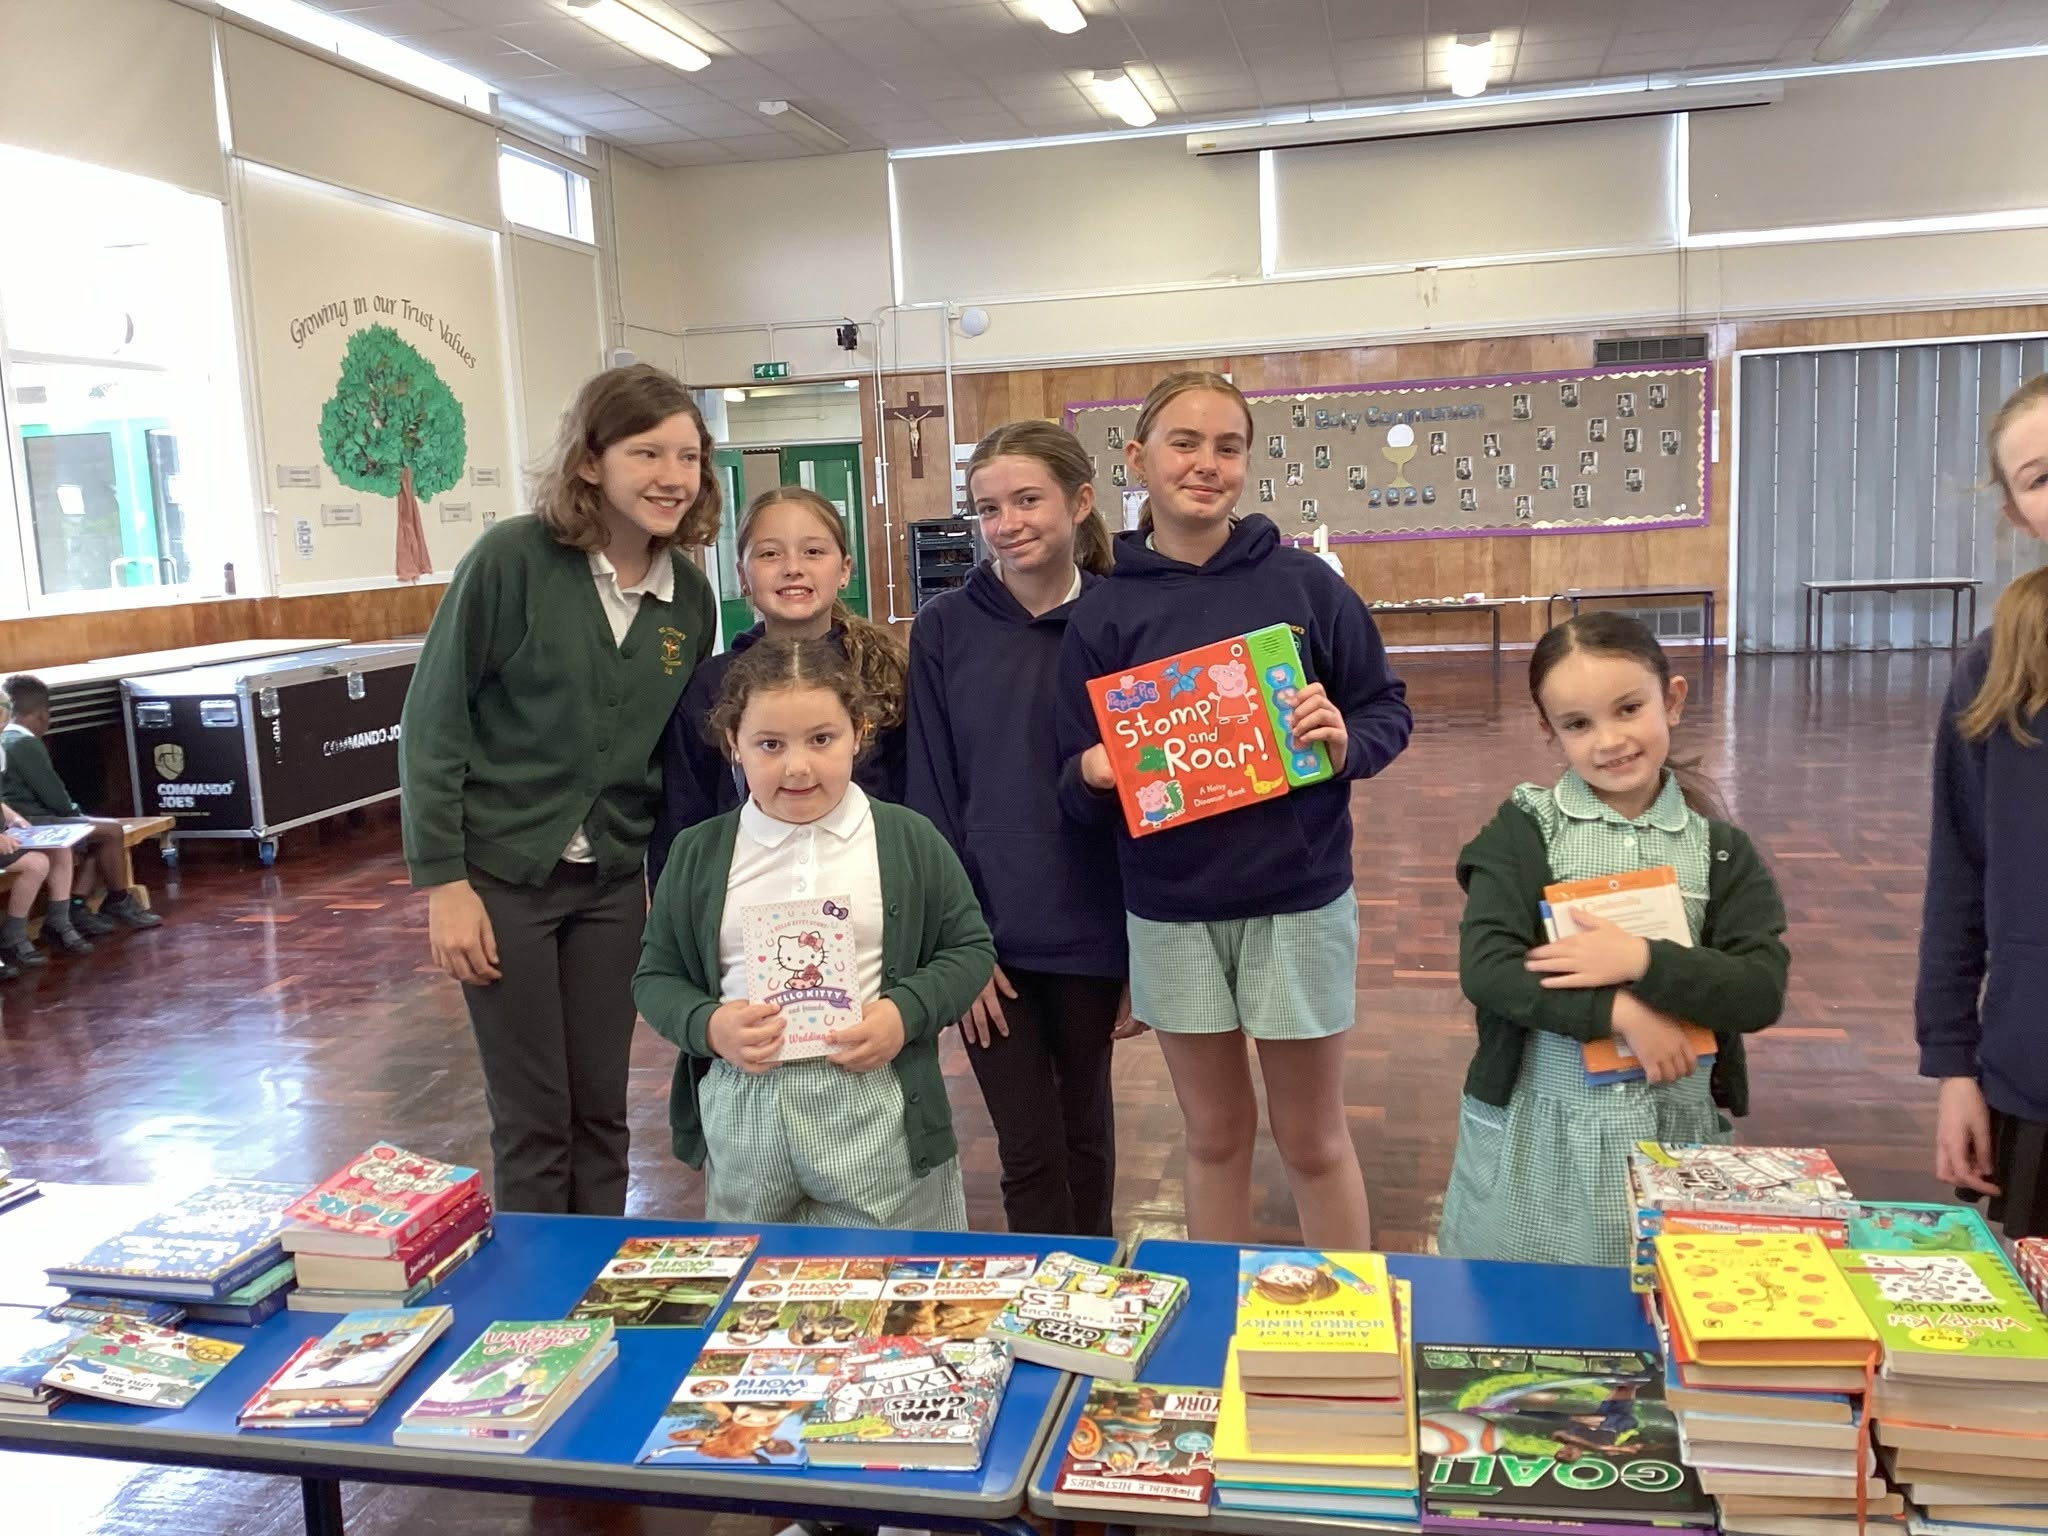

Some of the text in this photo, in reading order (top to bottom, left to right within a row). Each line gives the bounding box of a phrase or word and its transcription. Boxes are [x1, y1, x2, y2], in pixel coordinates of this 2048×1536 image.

[290, 295, 477, 370] Growing in our Trust Values
[1315, 404, 1485, 435] Holy Communion
[1108, 681, 1158, 710] Peppa Pig
[272, 718, 281, 743] TOP
[1116, 699, 1212, 749] Stomp
[1188, 726, 1219, 744] and
[1163, 726, 1270, 778] Roar!
[157, 782, 233, 796] COMMANDO
[1206, 783, 1227, 795] Noisy
[1227, 786, 1247, 799] Book
[158, 796, 195, 809] JOES
[805, 989, 843, 1000] KITTY
[787, 1281, 853, 1291] World
[787, 1289, 849, 1297] Animal
[933, 1281, 999, 1291] World
[933, 1288, 996, 1297] Animal
[1294, 1309, 1346, 1317] Books
[1893, 1302, 2003, 1314] HARD LUCK
[1038, 1320, 1098, 1339] GATES
[1242, 1319, 1304, 1329] HENRY
[1887, 1313, 2032, 1333] Wimpy Kid
[1041, 1330, 1088, 1347] TOM
[1968, 1339, 2016, 1351] DIA
[133, 1350, 173, 1368] SEA
[101, 1374, 154, 1388] LITTLE MISS
[102, 1380, 124, 1389] MEN
[734, 1378, 807, 1390] World
[859, 1370, 952, 1398] EXTRA
[733, 1388, 801, 1398] Animal
[890, 1396, 967, 1411] GATES
[1173, 1395, 1221, 1412] YORK
[898, 1409, 958, 1423] TOM
[1425, 1455, 1684, 1496] GOAL!
[1070, 1478, 1197, 1497] HORRIBLE HISTORIES
